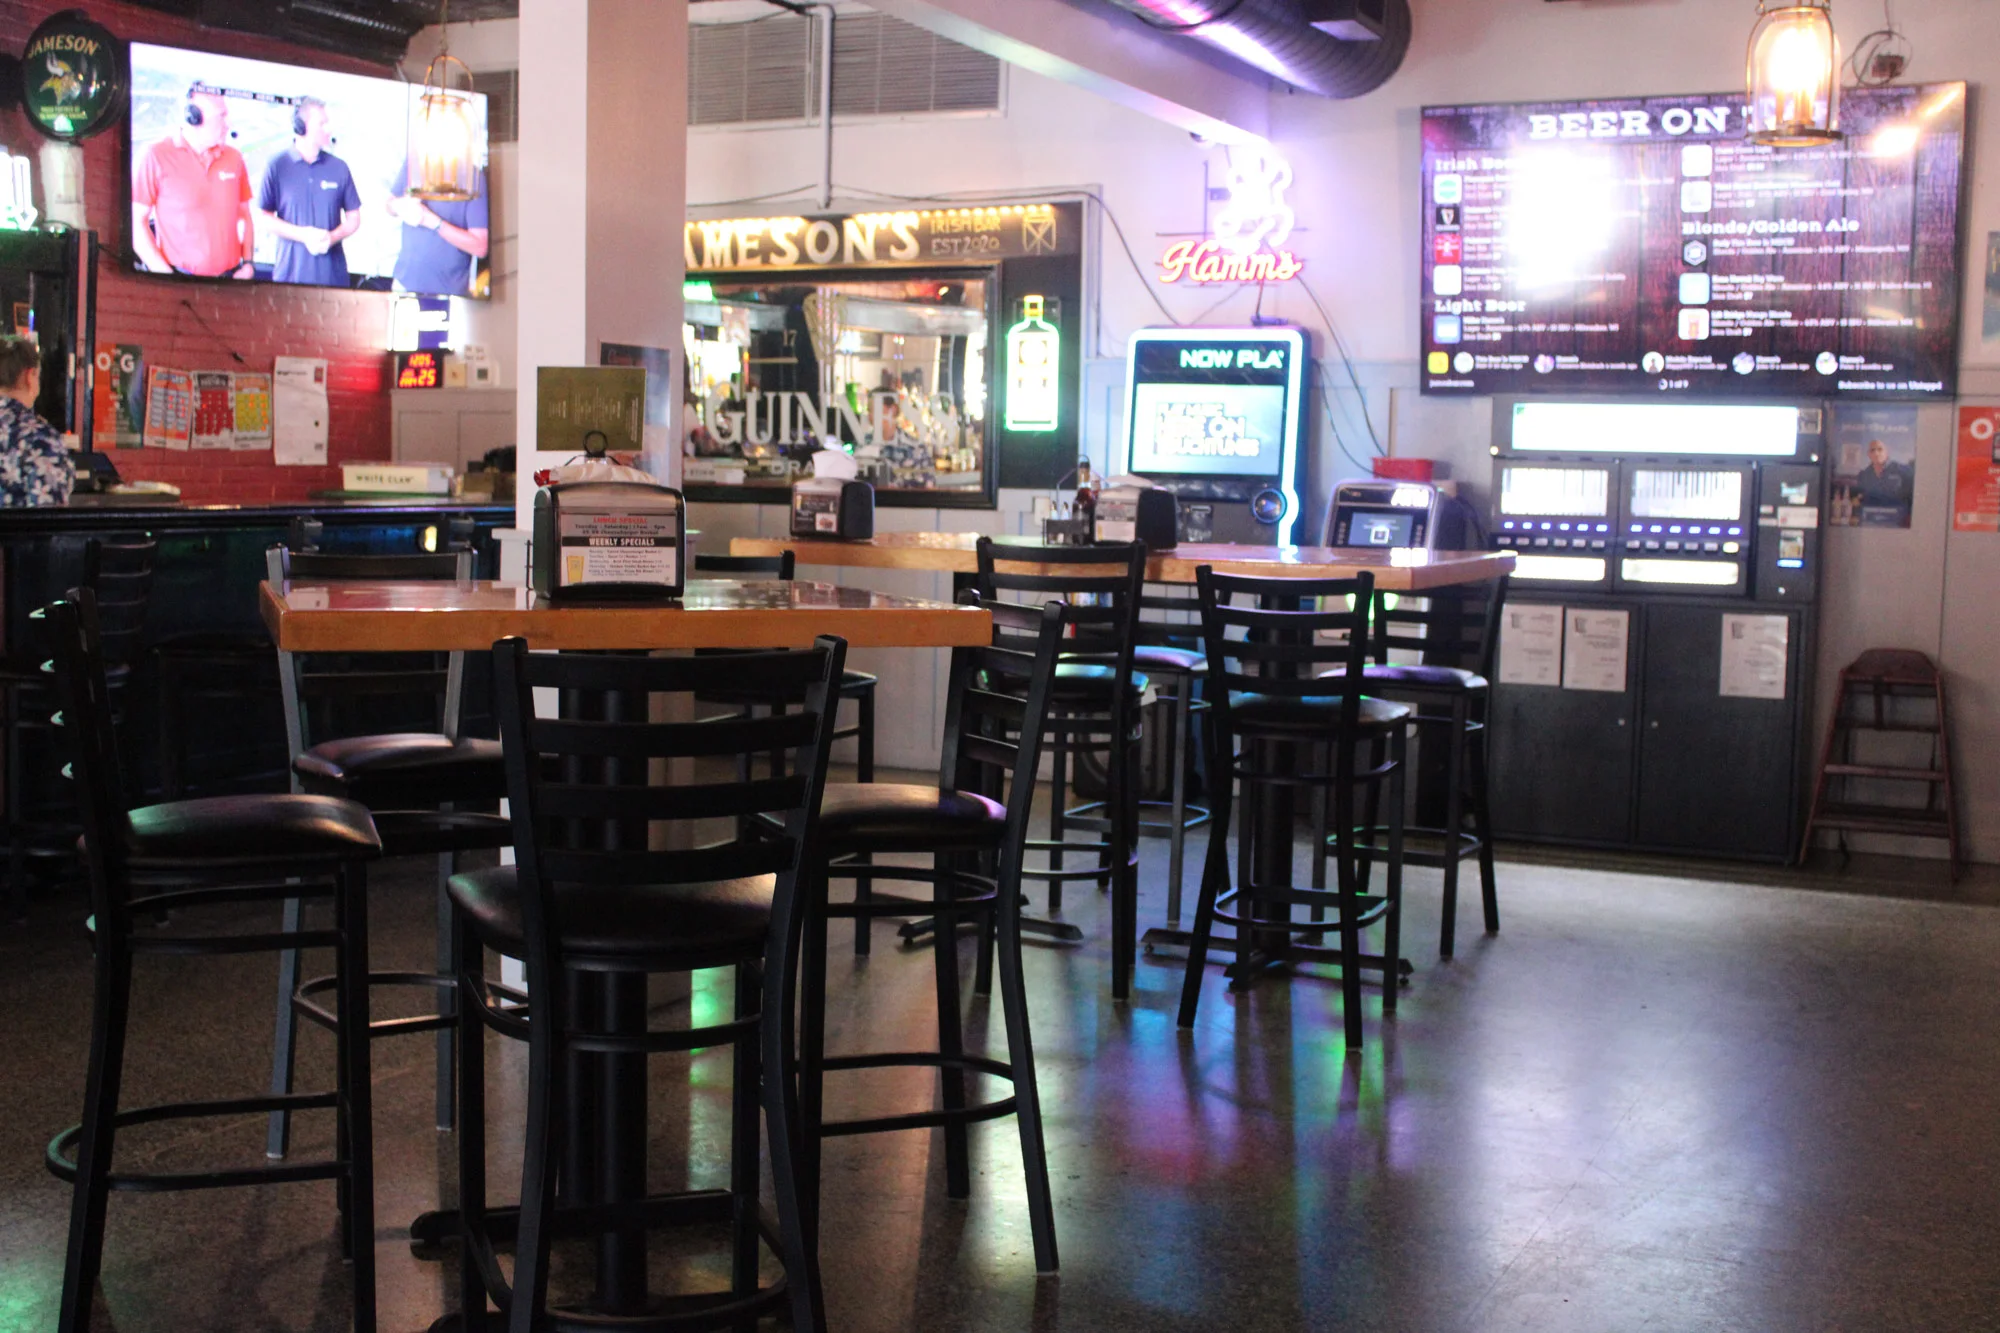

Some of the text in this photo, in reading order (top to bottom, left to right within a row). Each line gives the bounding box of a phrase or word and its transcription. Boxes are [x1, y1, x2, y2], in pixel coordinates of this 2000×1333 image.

[28, 34, 97, 58] JAMESON
[1528, 110, 1652, 139] BEER
[1661, 106, 1730, 135] ON
[1825, 217, 1860, 232] Ale
[932, 239, 962, 255] EST
[1180, 349, 1233, 368] NOW
[705, 382, 958, 446] GUINNESS
[771, 459, 882, 476] DRAHT
[356, 474, 411, 484] WHITE CLAW
[589, 537, 655, 546] WEEKLY SPECIALS
